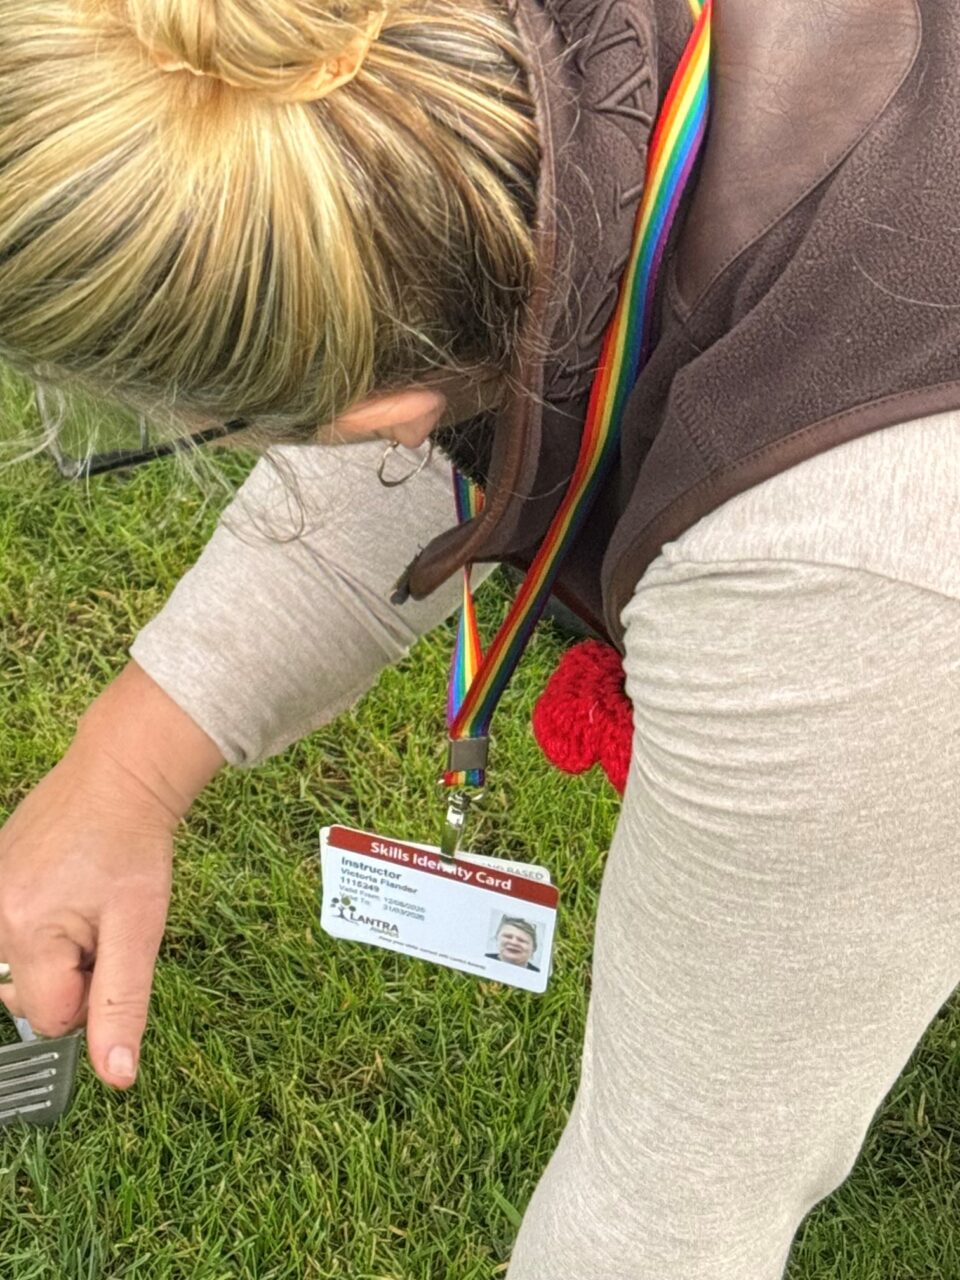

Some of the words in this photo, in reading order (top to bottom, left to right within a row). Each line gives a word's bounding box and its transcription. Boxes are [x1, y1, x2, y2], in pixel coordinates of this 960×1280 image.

[341, 856, 402, 880] Instructor
[341, 867, 378, 884] Victoria
[370, 841, 410, 862] Skills
[475, 871, 513, 891] Card
[350, 911, 399, 933] LANTRA
